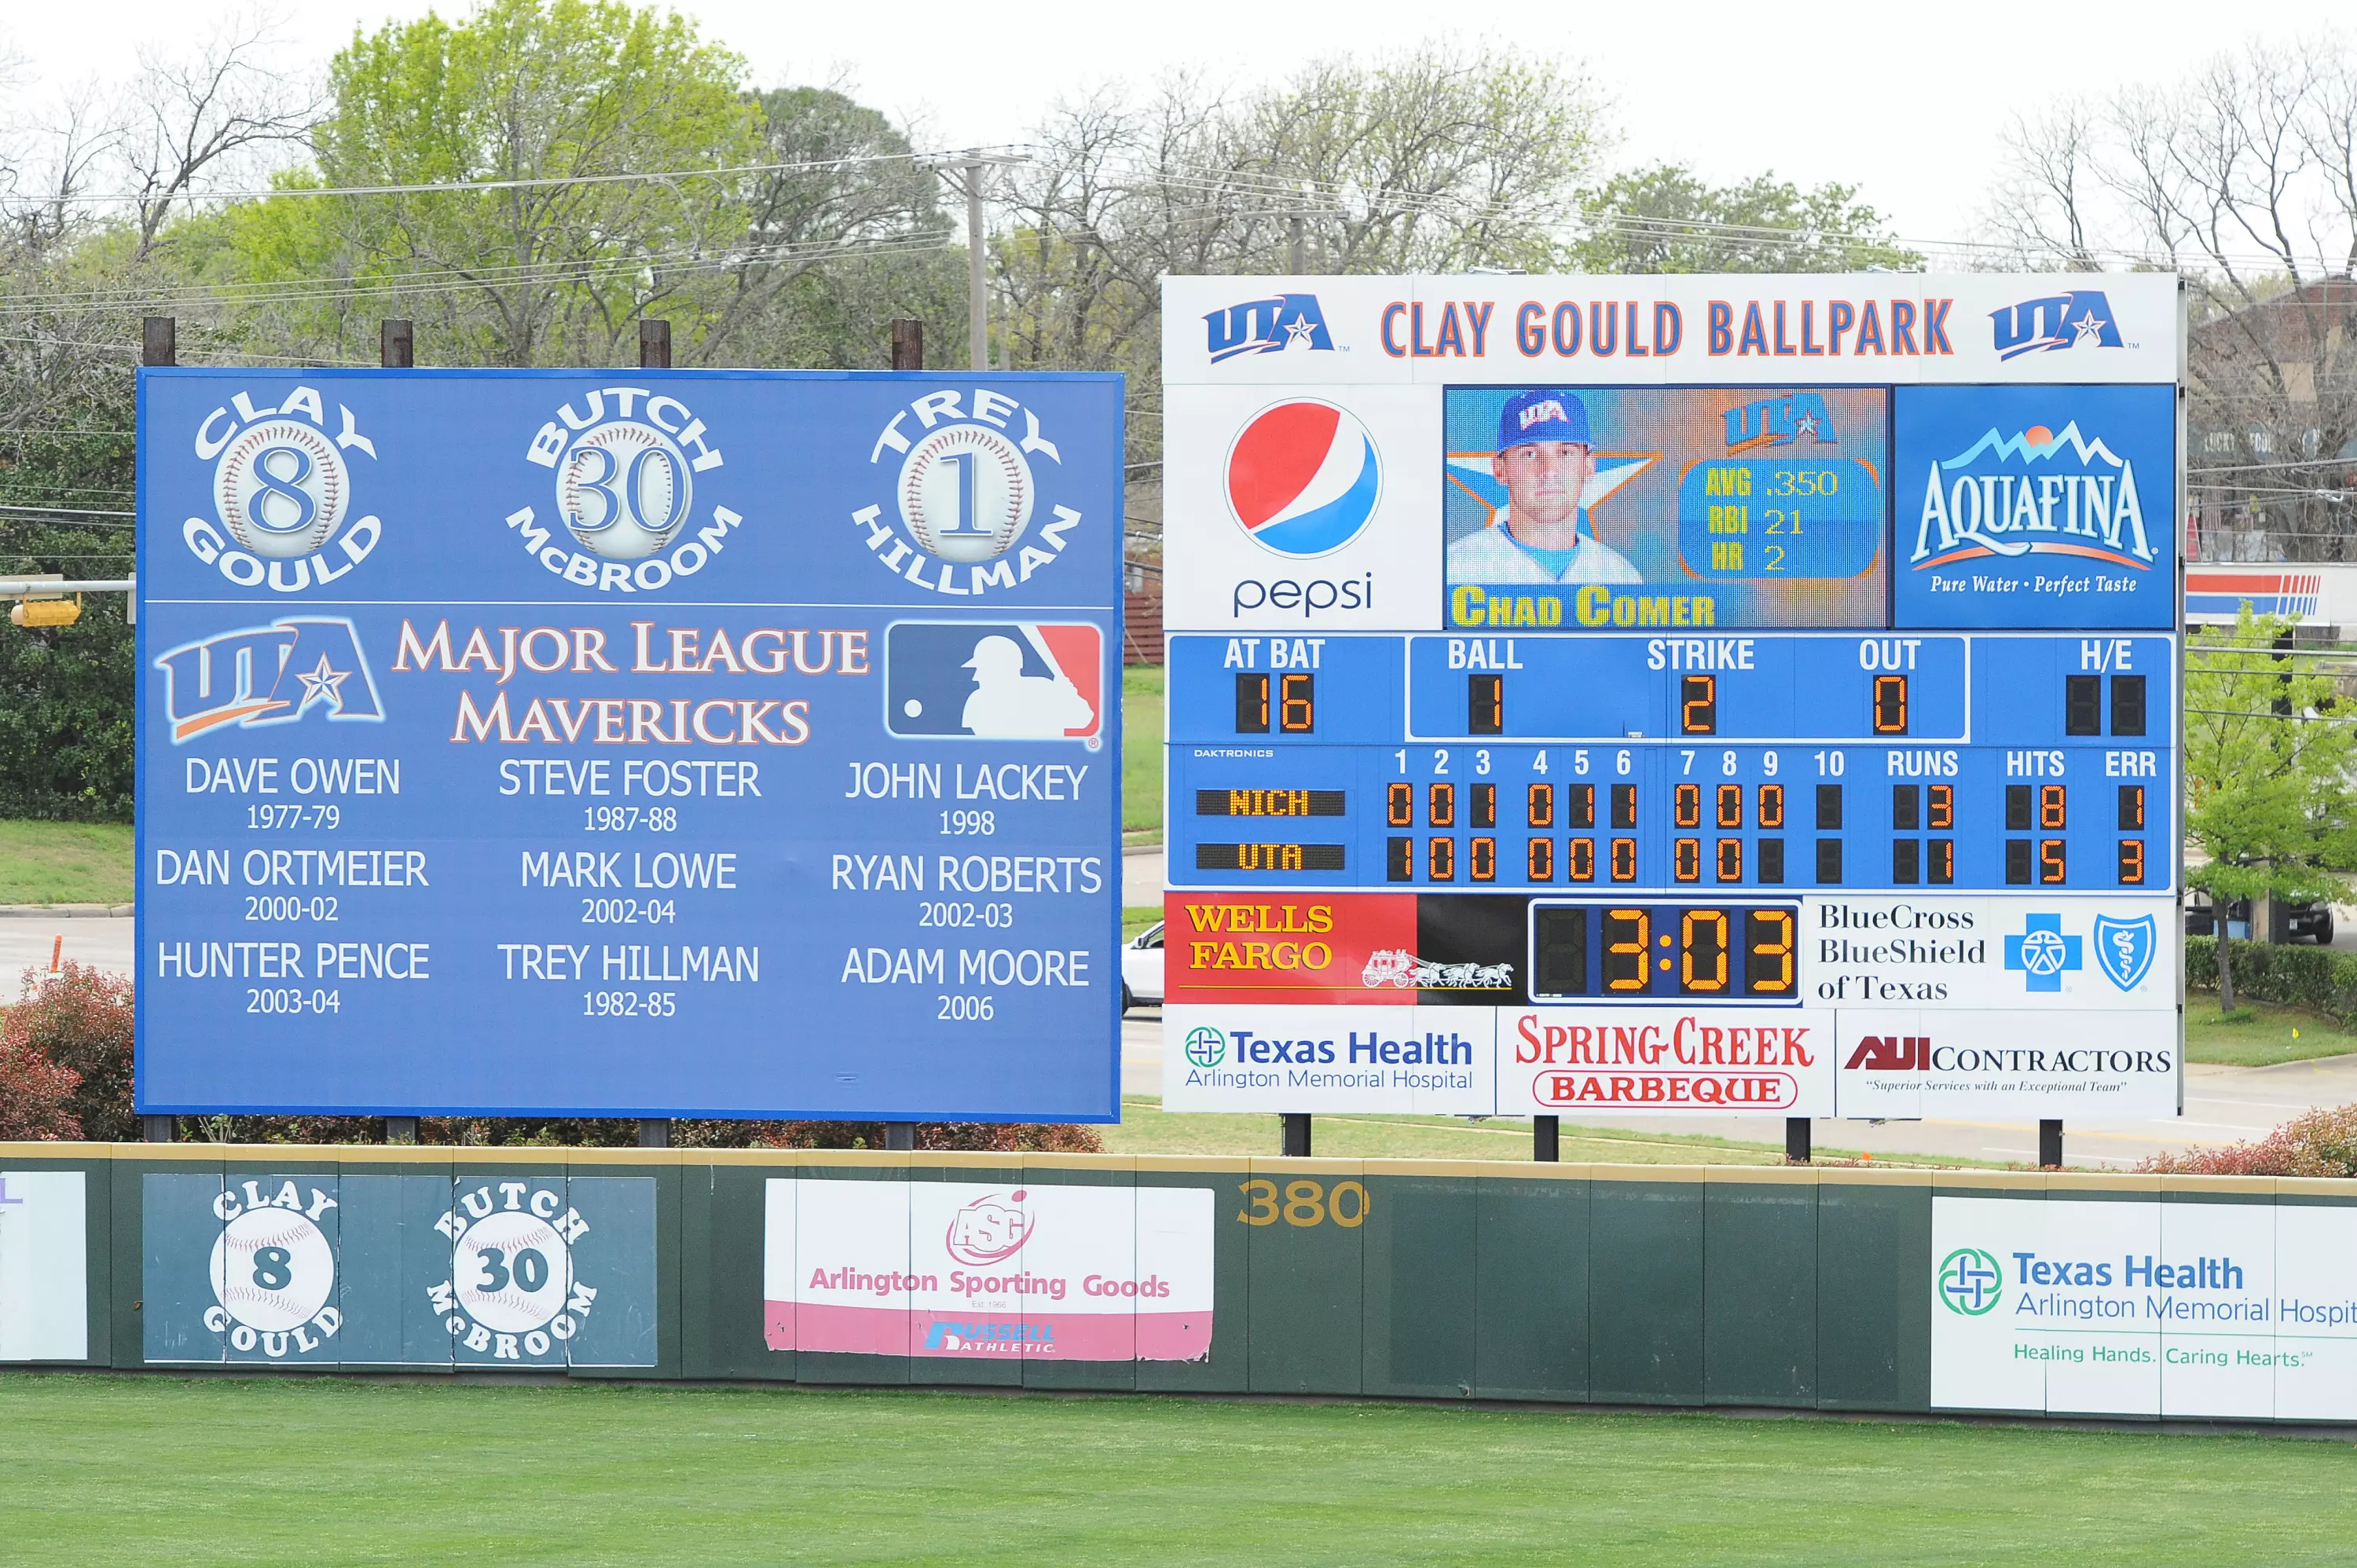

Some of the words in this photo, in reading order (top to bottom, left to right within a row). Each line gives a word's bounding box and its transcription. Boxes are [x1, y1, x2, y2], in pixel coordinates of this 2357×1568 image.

[1380, 302, 1495, 357] CLAY
[1516, 302, 1683, 357] GOULD
[1708, 299, 1954, 357] BALLPARK
[195, 386, 377, 460] CLAY
[526, 387, 724, 472] BUTCH
[871, 389, 1061, 465] TREY
[247, 446, 316, 533] 8
[569, 445, 687, 532] 30
[940, 451, 993, 537] 1
[1706, 467, 1750, 496] AVG
[1767, 471, 1838, 495] .350
[1708, 505, 1747, 533] RBI
[1765, 510, 1803, 534] 21
[1911, 460, 2154, 562] AQUAFINA
[183, 515, 381, 592] GOULD
[851, 504, 1082, 595] HILLMAN
[1712, 542, 1743, 570] HR
[1765, 546, 1785, 570] 2
[1234, 572, 1372, 617] pepsi
[1930, 576, 1967, 592] Pure
[1972, 576, 2018, 592] Water
[2033, 575, 2090, 597] Perfect
[2095, 576, 2137, 592] Taste
[1223, 639, 1260, 669] AT
[1270, 639, 1325, 669] BAT
[1448, 639, 1524, 669] BALL
[1647, 639, 1755, 670] STRIKE
[1860, 639, 1922, 670] OUT
[2081, 639, 2133, 673] H/E
[1261, 674, 1312, 730] 16
[1684, 676, 1714, 731] 2
[1875, 676, 1905, 731] 0
[1194, 749, 1274, 758] DAKTRONICS
[1395, 750, 1406, 774] 1
[1435, 750, 1449, 774] 2
[1475, 750, 1491, 774] 3
[1533, 750, 1549, 774] 4
[1574, 750, 1589, 774] 5
[1617, 750, 1631, 775] 6
[1681, 751, 1695, 775] 7
[1722, 751, 1737, 775] 8
[1763, 751, 1779, 776] 9
[1813, 751, 1844, 776] 10
[1888, 750, 1959, 777] RUNS
[2007, 750, 2065, 776] HITS
[2105, 751, 2157, 777] ERR
[185, 758, 278, 794] DAVE
[291, 758, 400, 794] OWEN
[499, 759, 610, 795] STEVE
[624, 760, 762, 797] FOSTER
[845, 762, 940, 798] JOHN
[956, 764, 1087, 800] LACKEY
[247, 804, 339, 830] 1977-79
[585, 807, 676, 832] 1987-88
[1389, 784, 1411, 824] 0
[1431, 784, 1453, 824] 0
[1530, 784, 1552, 825] 0
[1676, 785, 1699, 826] 0
[1717, 785, 1740, 826] 0
[1759, 785, 1782, 826] 0
[1931, 786, 1952, 826] 3
[2041, 786, 2064, 826] 8
[940, 811, 995, 835] 1998
[156, 849, 229, 885] DAN
[243, 850, 429, 887] ORTMEIER
[522, 852, 621, 887] MARK
[635, 852, 736, 888] LOWE
[831, 855, 924, 892] RYAN
[939, 855, 1102, 894] ROBERTS
[1239, 844, 1301, 870] UTA
[1431, 837, 1453, 878] 0
[1472, 837, 1494, 878] 0
[1529, 837, 1552, 878] 0
[1571, 838, 1593, 879] 0
[1613, 838, 1635, 879] 0
[1676, 839, 1699, 880] 0
[1717, 839, 1740, 880] 0
[2041, 840, 2064, 881] 5
[2122, 840, 2143, 881] 3
[244, 896, 338, 921] 2000-02
[581, 899, 676, 924] 2002-04
[919, 902, 1014, 928] 2002-03
[1185, 905, 1334, 933] WELLS
[1818, 904, 1974, 929] BlueCross
[159, 943, 304, 978] HUNTER
[317, 943, 429, 979] PENCE
[497, 944, 590, 980] TREY
[603, 945, 758, 982] HILLMAN
[841, 947, 944, 984] ADAM
[959, 949, 1089, 986] MOORE
[1188, 942, 1333, 970] FARGO
[1610, 910, 1792, 991] 3:03
[1818, 939, 1985, 964] BlueShield
[246, 989, 340, 1014] 2003-04
[583, 991, 676, 1017] 1982-85
[1818, 975, 1853, 1000] of
[1861, 976, 1948, 1000] Texas
[937, 996, 994, 1020] 2006
[1230, 1031, 1336, 1064] Texas
[1350, 1032, 1472, 1065] Health
[1186, 1069, 1279, 1089] Arlington
[1288, 1069, 1384, 1088] Memorial
[1393, 1070, 1472, 1091] Hospital
[1551, 1076, 1780, 1105] BARBEQUE
[1925, 1080, 1970, 1091] Services
[1974, 1080, 1998, 1091] with
[2001, 1082, 2015, 1091] an
[2020, 1081, 2086, 1094] Exceptional
[213, 1180, 339, 1222] CLAY
[434, 1181, 590, 1245] BUTCH
[1237, 1180, 1370, 1229] 380
[253, 1246, 292, 1291] 8
[476, 1247, 550, 1294] 30
[808, 1268, 938, 1295] Arlington
[950, 1272, 1066, 1301] Sporting
[1082, 1275, 1170, 1298] Goods
[2012, 1252, 2112, 1287] Texas
[2125, 1255, 2243, 1289] Health
[2015, 1292, 2135, 1320] Arlington
[2146, 1295, 2270, 1322] Memorial
[203, 1303, 343, 1358] GOULD
[923, 1321, 1055, 1350] RUSSELL
[960, 1342, 1054, 1353] ATHLETIC
[2014, 1343, 2085, 1364] Healing
[2091, 1346, 2157, 1364] Hands.
[2166, 1348, 2228, 1367] Caring
